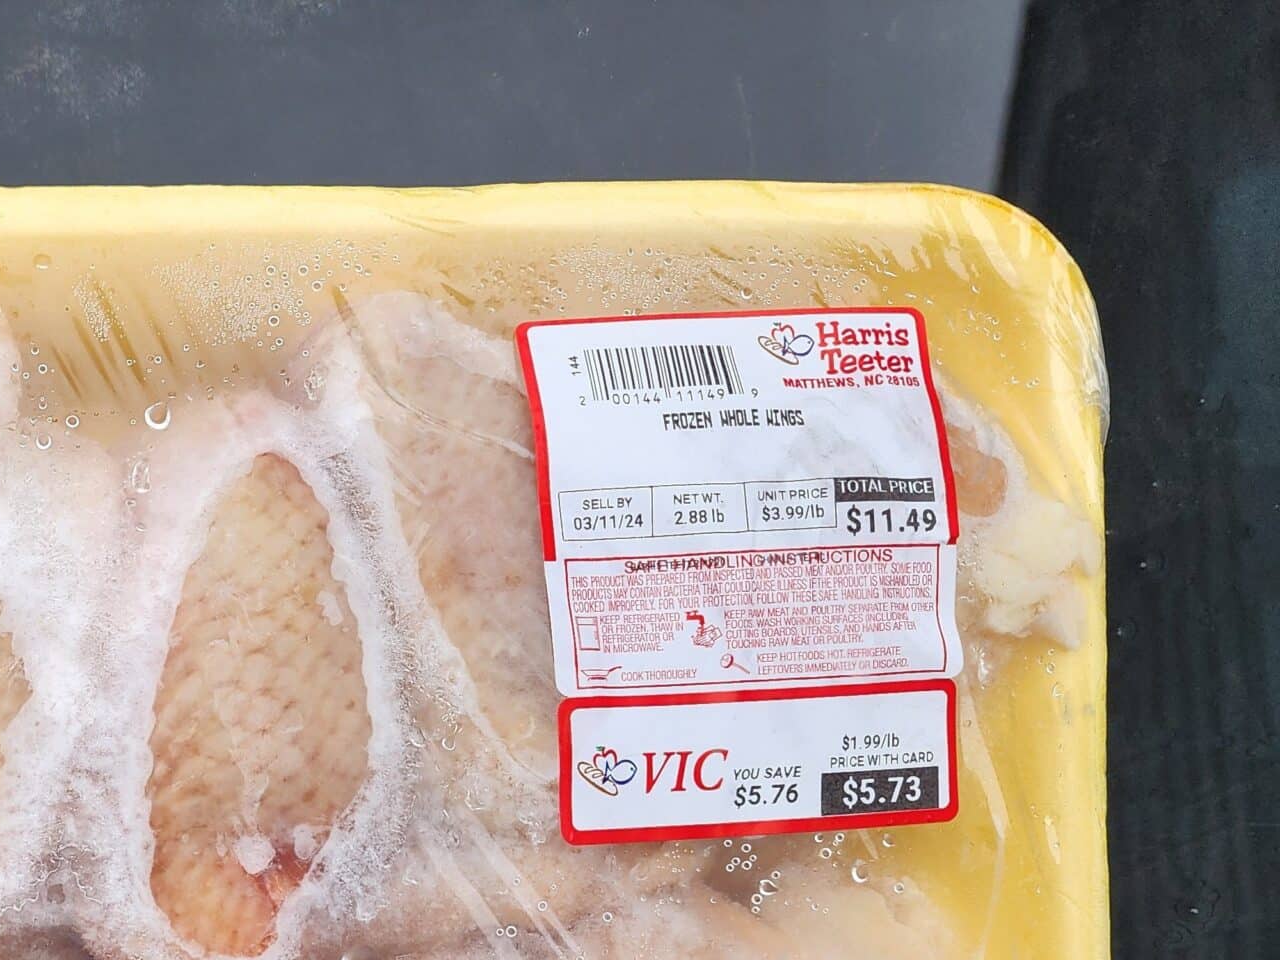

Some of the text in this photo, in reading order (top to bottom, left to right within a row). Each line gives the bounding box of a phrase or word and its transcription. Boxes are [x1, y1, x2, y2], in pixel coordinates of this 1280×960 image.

[816, 321, 909, 347] Harris
[568, 356, 581, 376] 144
[820, 349, 913, 375] Teeter
[782, 374, 920, 389] MATTHEWS, NC 28105
[663, 408, 805, 430] FROZEN WHOLE WINGS
[757, 487, 829, 501] UNIT PRICE
[839, 479, 934, 494] TOTAL PRICE
[582, 497, 632, 510] SELL BY
[673, 492, 724, 505] NET WT.
[573, 514, 644, 531] 03/11/24
[674, 508, 725, 525] 2.88 lb
[761, 505, 825, 522] $3.99/lb
[846, 504, 936, 536] $11.49
[769, 549, 893, 567] INSTRUCTIONS
[621, 669, 697, 681] COOK THOROUGHLY
[841, 733, 900, 751] $1.99/lb
[830, 751, 934, 769] PRICE WITH CARD
[642, 748, 729, 794] VIC
[733, 765, 802, 780] YOU SAVE
[733, 783, 799, 809] $5.76
[842, 775, 922, 809] $5.73
